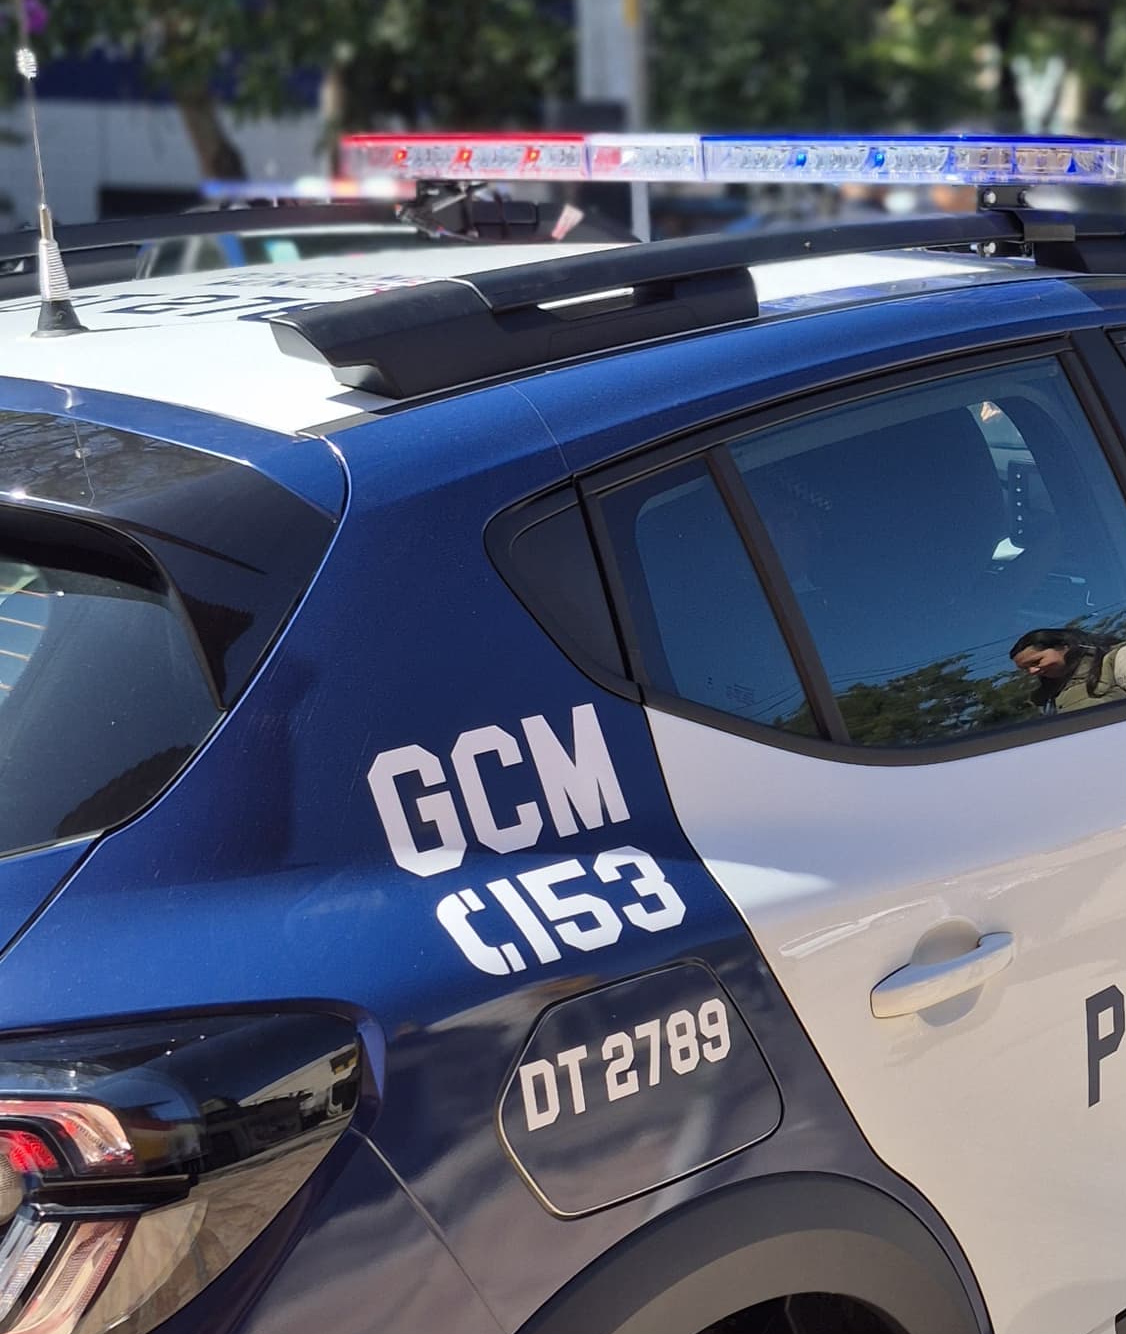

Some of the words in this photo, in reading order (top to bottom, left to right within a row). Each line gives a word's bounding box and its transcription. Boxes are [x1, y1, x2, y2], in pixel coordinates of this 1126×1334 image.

[367, 703, 631, 877] GCM
[486, 845, 687, 966] 153
[519, 1058, 588, 1132] DT
[601, 998, 731, 1102] 2789
